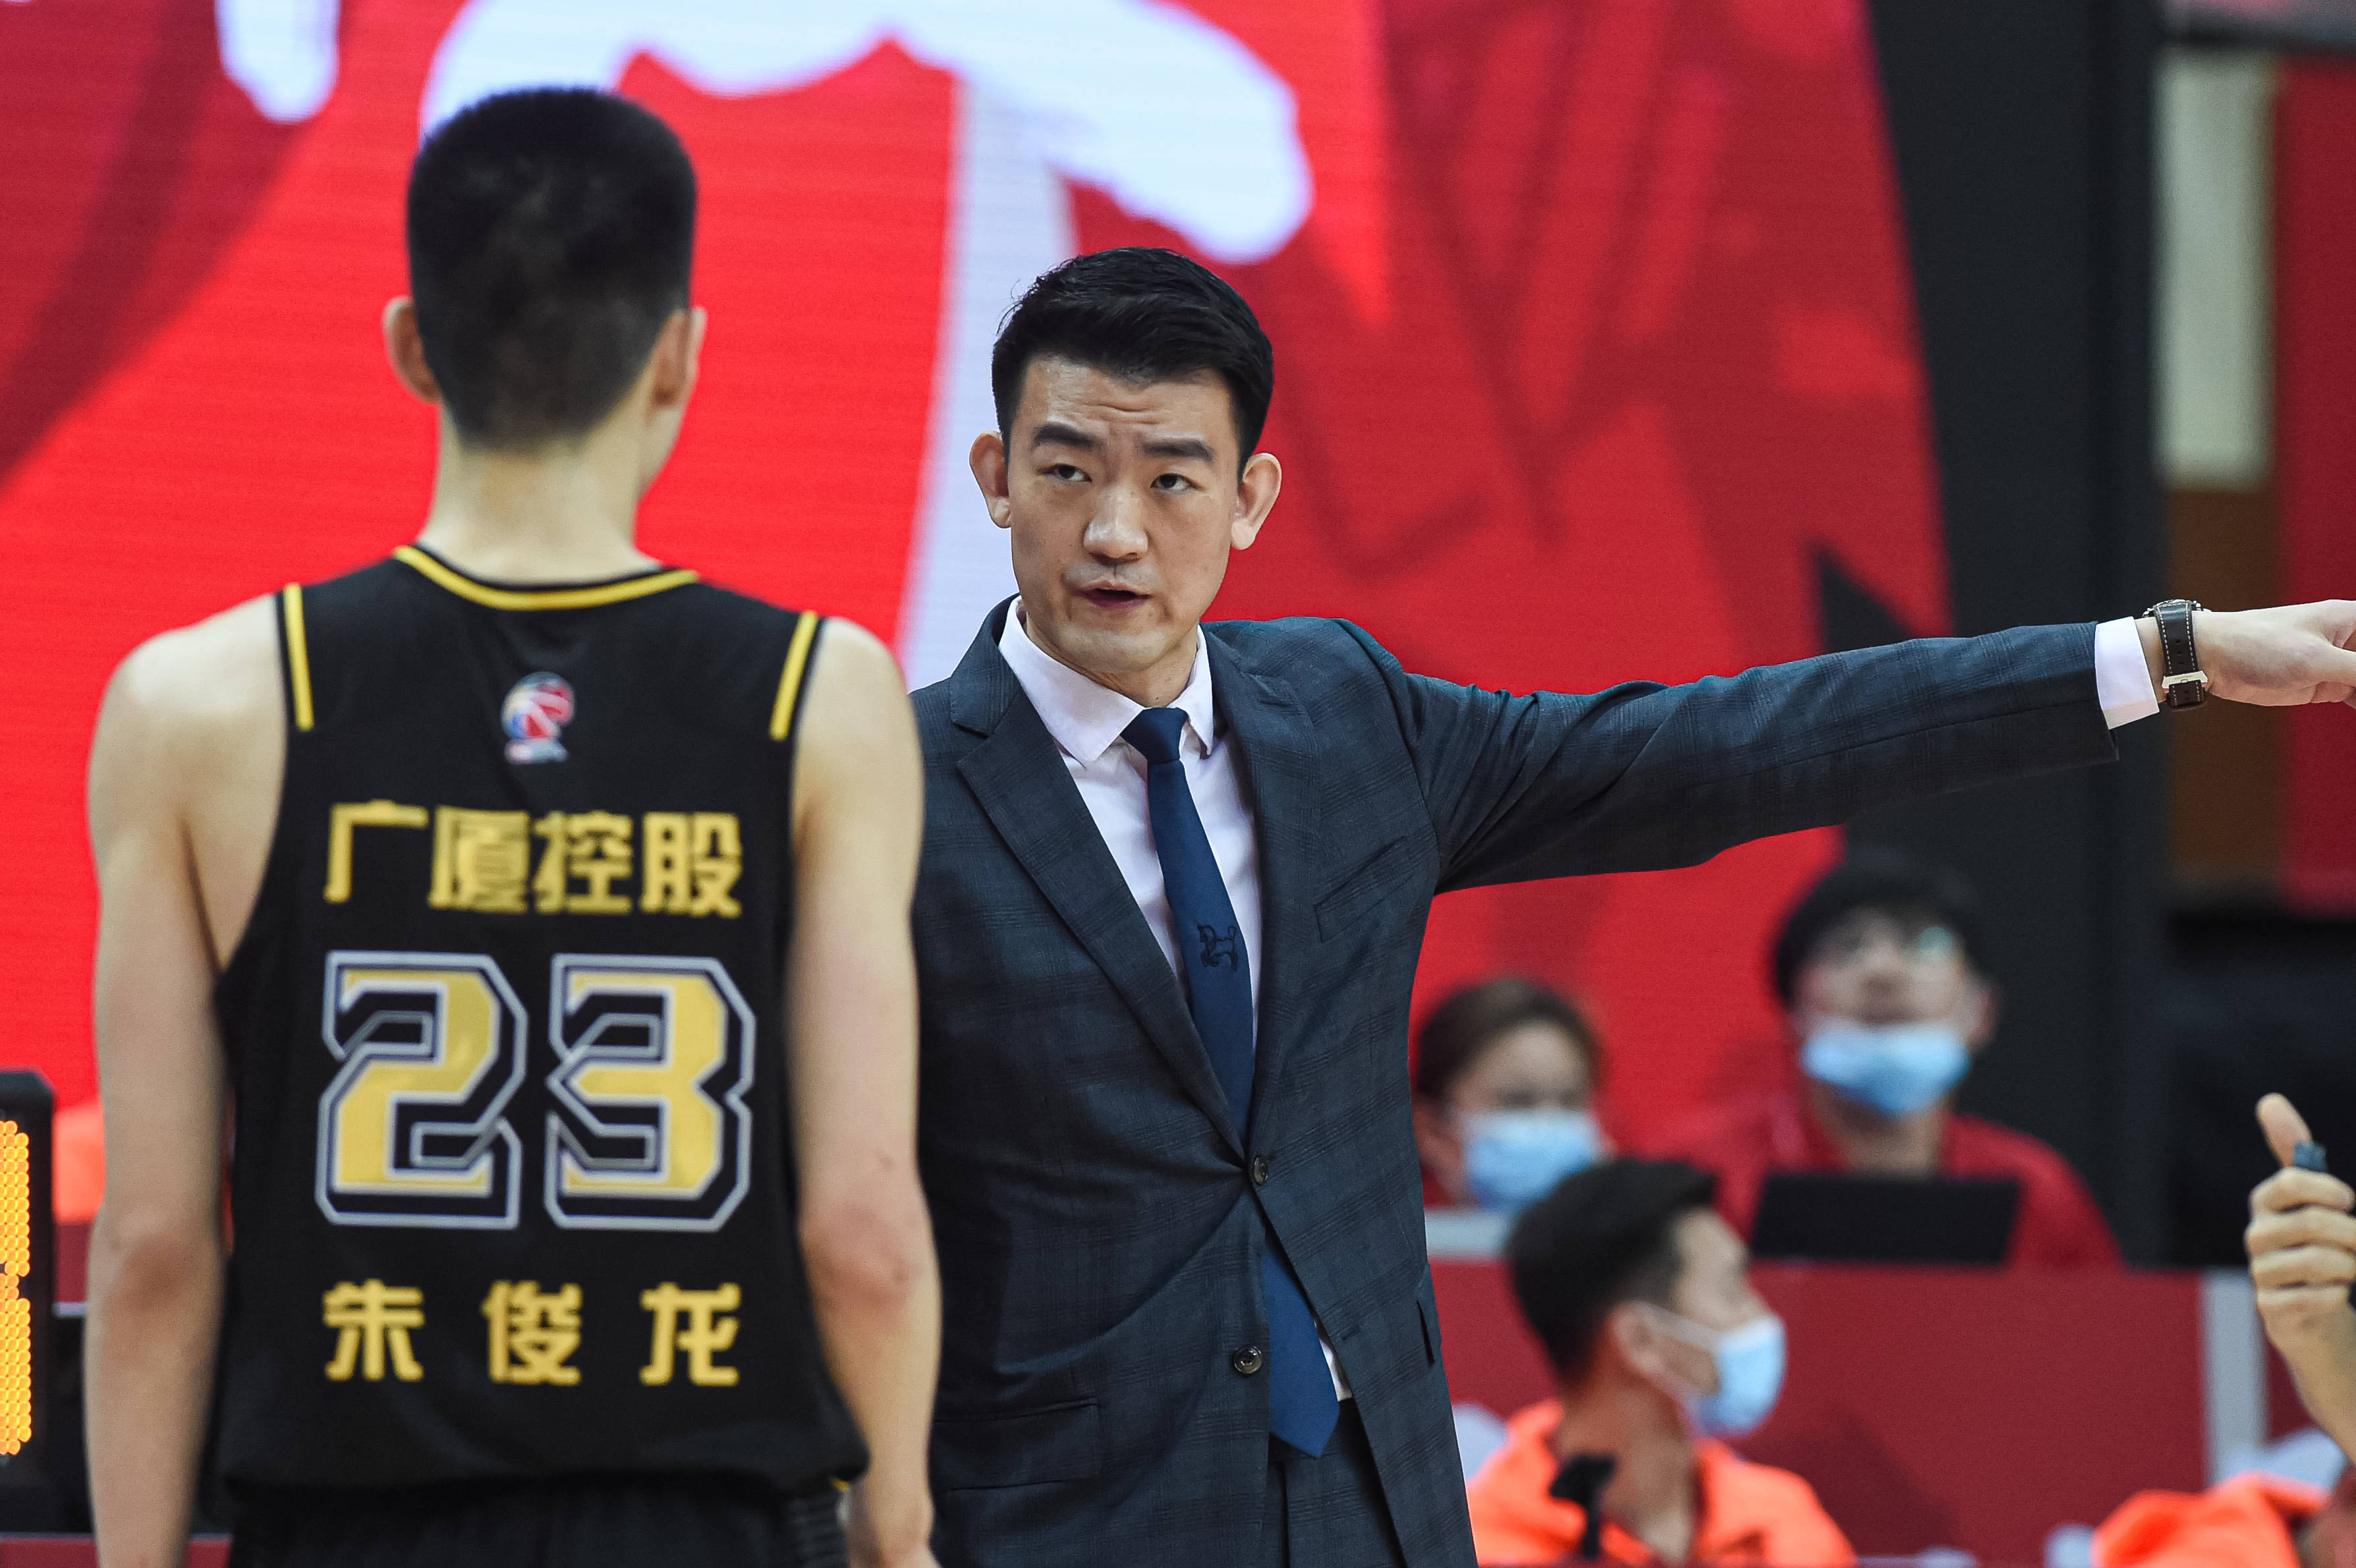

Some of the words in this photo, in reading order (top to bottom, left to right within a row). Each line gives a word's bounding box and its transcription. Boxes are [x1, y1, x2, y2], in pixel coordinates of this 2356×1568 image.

[324, 800, 743, 918] 广厦控股
[315, 951, 756, 1231] 23
[323, 1279, 741, 1387] 朱俊龙
